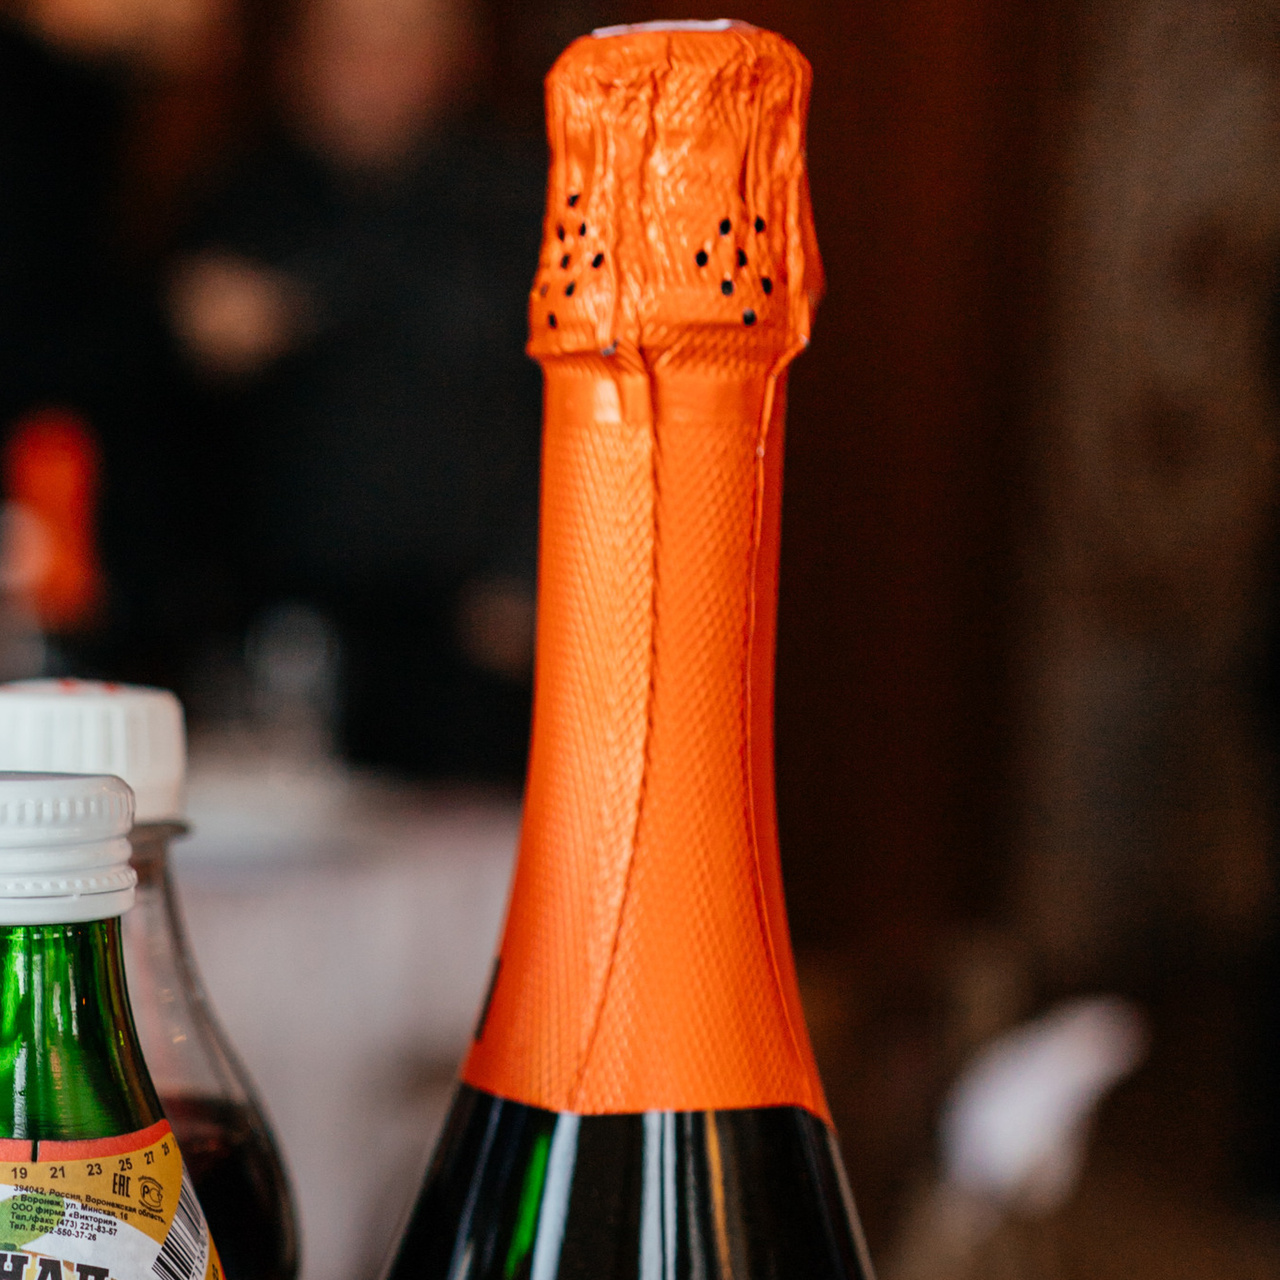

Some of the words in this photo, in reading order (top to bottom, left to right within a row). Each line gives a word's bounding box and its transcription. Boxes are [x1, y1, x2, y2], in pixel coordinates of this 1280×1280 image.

[11, 1167, 28, 1179] 19
[49, 1165, 66, 1179] 21
[86, 1163, 103, 1176] 23
[118, 1157, 133, 1172] 25
[144, 1151, 154, 1165] 27
[11, 1202, 33, 1212] ООО
[35, 1205, 66, 1218] фирма
[69, 1211, 118, 1228] «Виктория»
[13, 1183, 47, 1196] 394042,
[48, 1188, 82, 1202] Россия,
[85, 1195, 137, 1215] Воронежская
[138, 1208, 166, 1225] область,
[21, 1194, 63, 1209] Воронеж,
[65, 1201, 78, 1211] ул.
[80, 1204, 118, 1219] Минская,
[119, 1212, 128, 1221] 16
[9, 1220, 29, 1231] Тел.
[30, 1223, 97, 1241] 8-952-550-37-26
[10, 1212, 54, 1226] Тел./факс
[56, 1218, 78, 1230] (473)
[79, 1222, 118, 1237] 221-83-57
